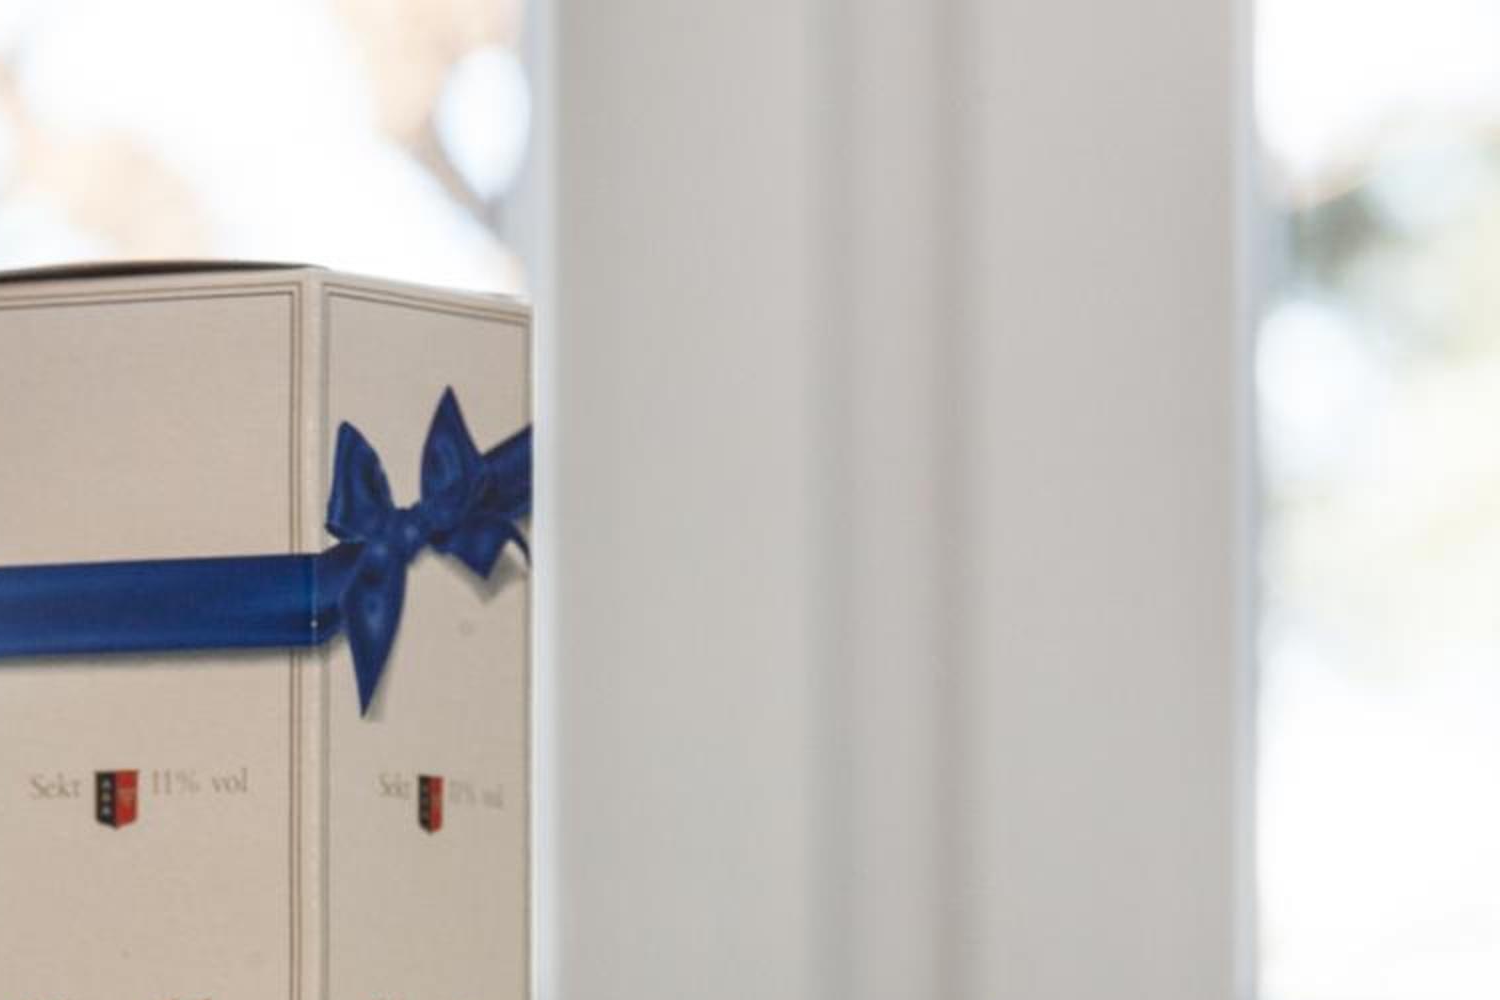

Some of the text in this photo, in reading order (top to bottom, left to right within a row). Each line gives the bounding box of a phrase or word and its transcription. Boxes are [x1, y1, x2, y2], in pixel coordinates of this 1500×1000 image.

[29, 768, 248, 799] Sekt 11% vol
